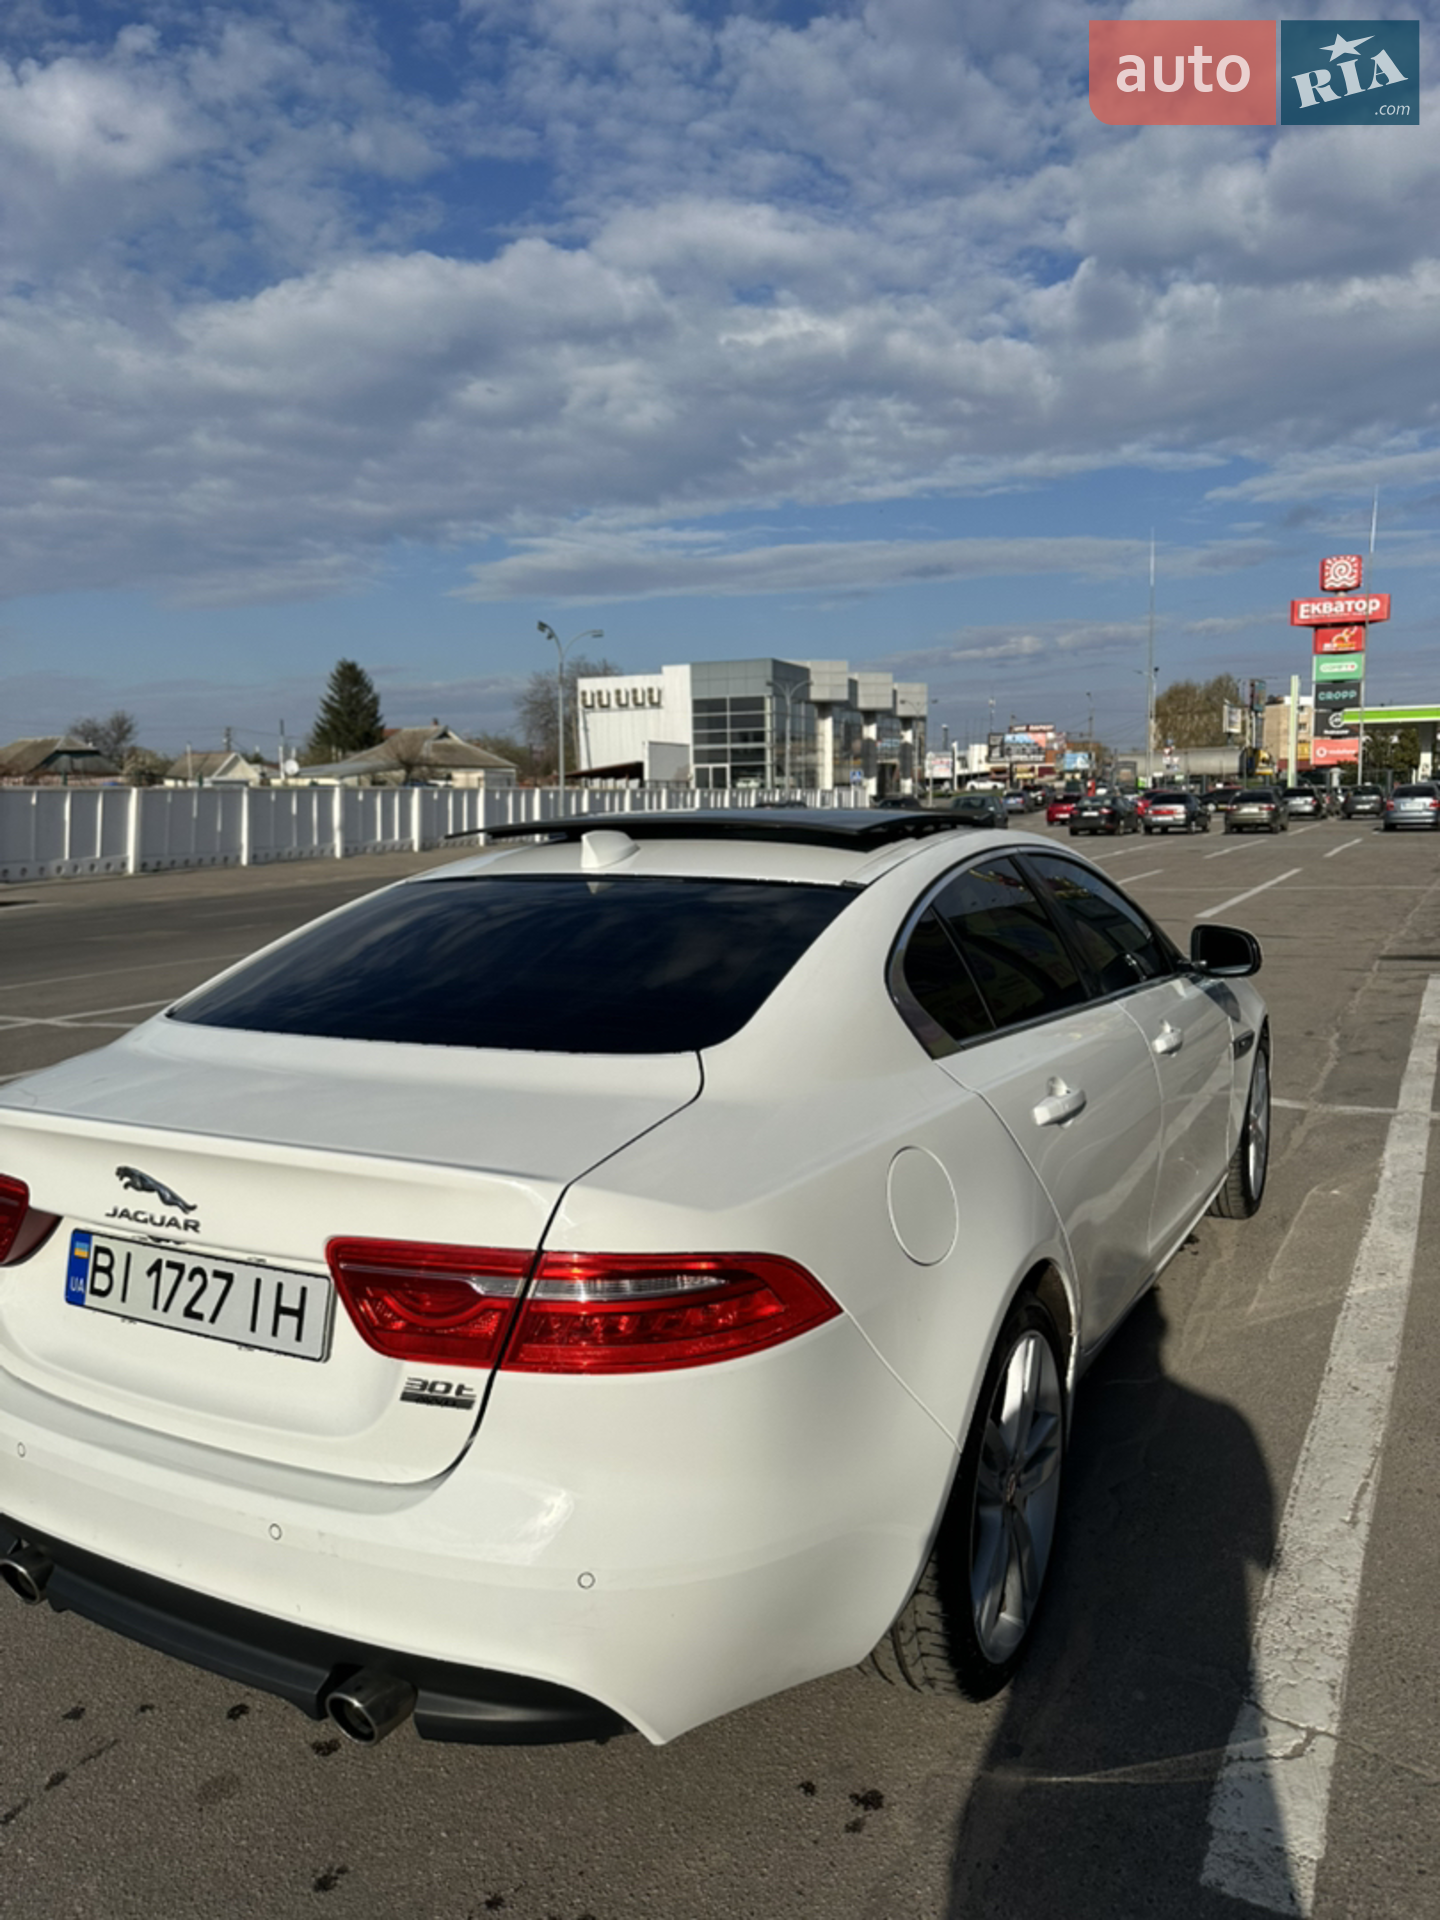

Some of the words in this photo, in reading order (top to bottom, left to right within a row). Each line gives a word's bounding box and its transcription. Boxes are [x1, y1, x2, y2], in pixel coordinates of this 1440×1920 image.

[1318, 689, 1357, 701] CROPP
[105, 1206, 201, 1233] JAGUAR
[69, 1276, 85, 1293] UA
[89, 1245, 132, 1303] BI
[146, 1257, 234, 1325] 1727
[249, 1277, 308, 1342] IH
[404, 1377, 477, 1398] 30t
